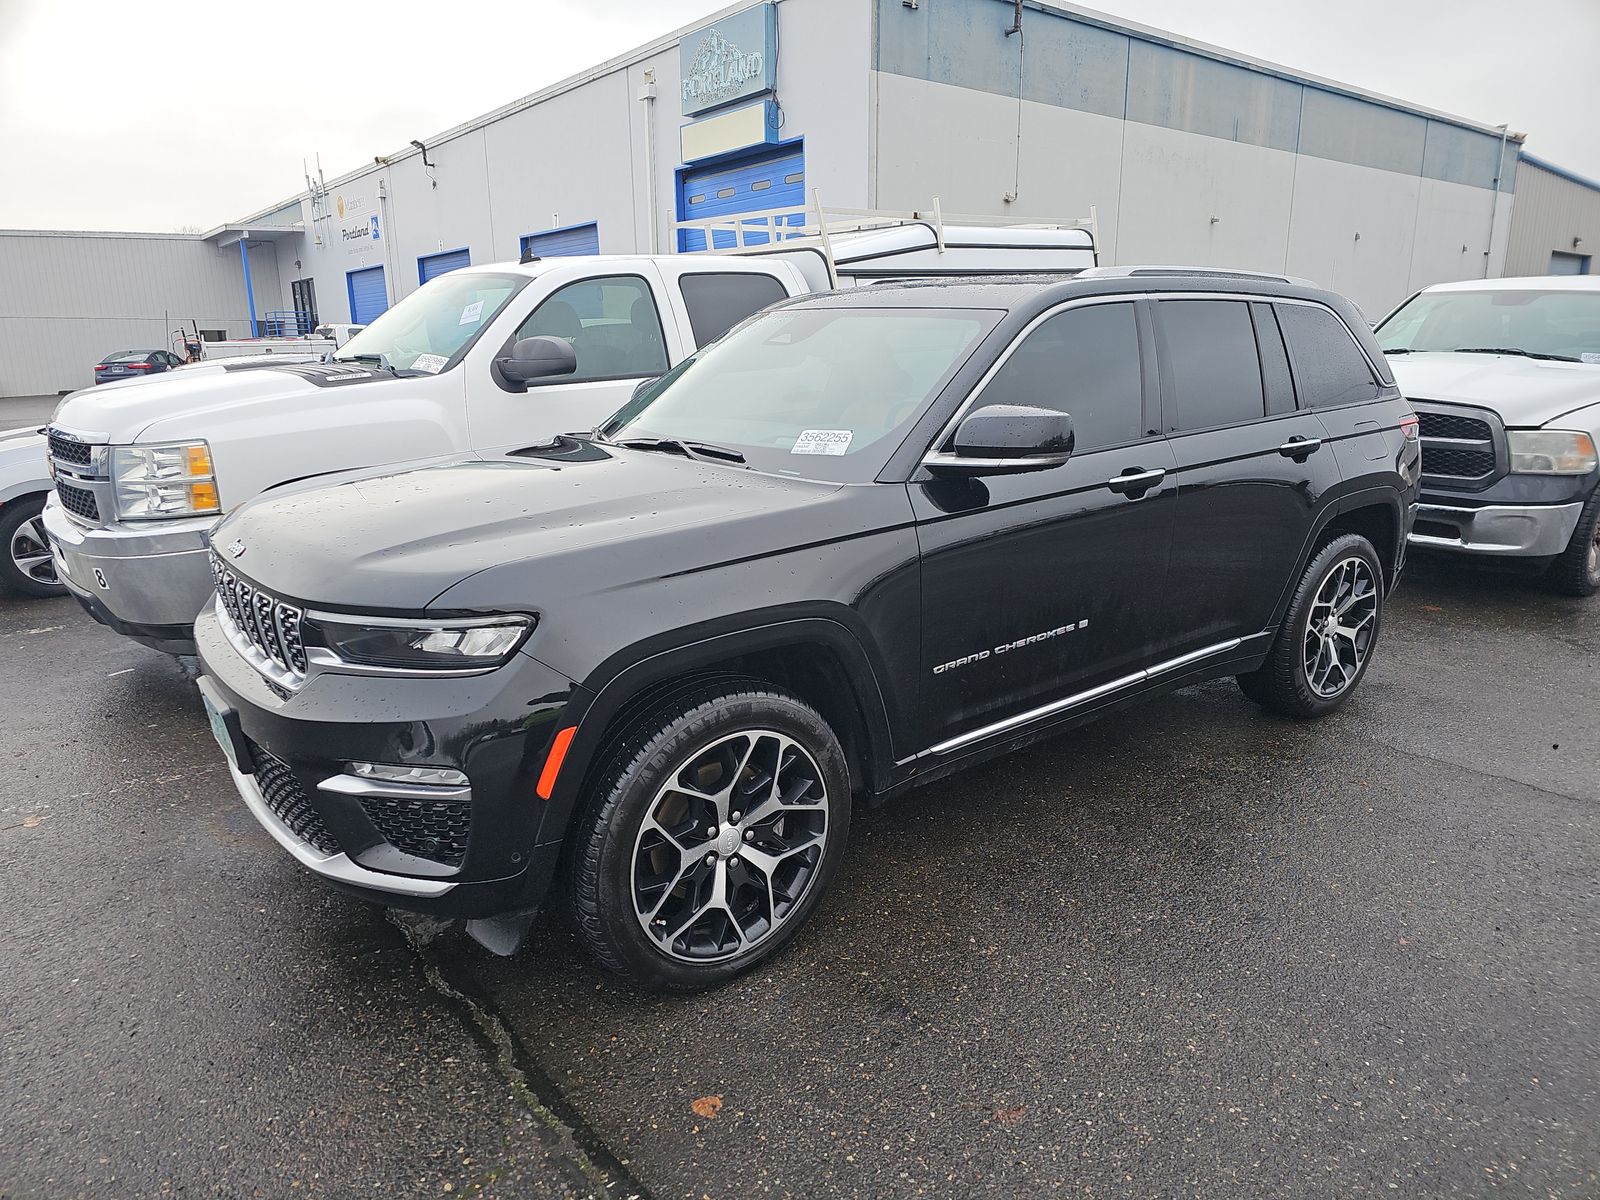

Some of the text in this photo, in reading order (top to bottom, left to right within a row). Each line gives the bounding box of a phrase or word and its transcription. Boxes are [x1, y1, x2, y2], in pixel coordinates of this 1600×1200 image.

[342, 222, 369, 241] Portland
[801, 432, 851, 443] 3562255
[95, 569, 106, 588] 8
[932, 623, 1076, 675] GRAND CHEROKEE
